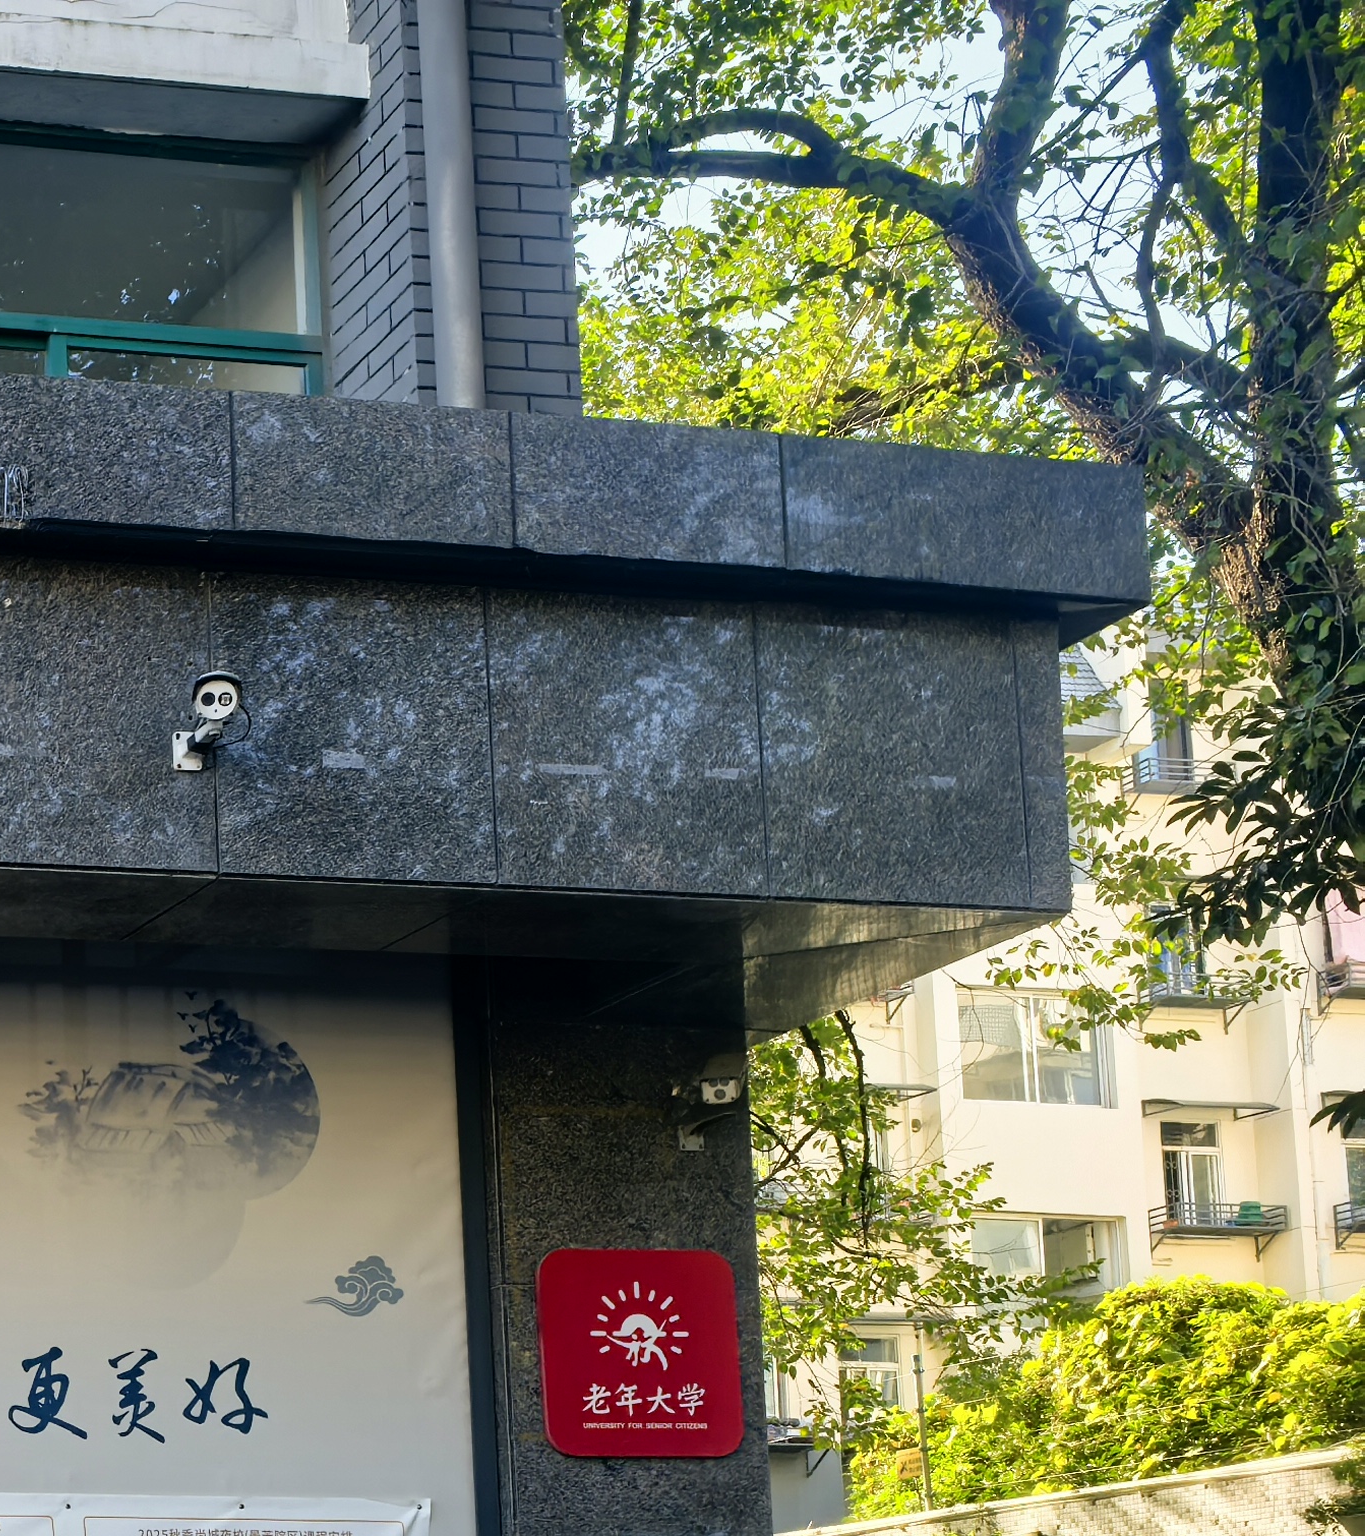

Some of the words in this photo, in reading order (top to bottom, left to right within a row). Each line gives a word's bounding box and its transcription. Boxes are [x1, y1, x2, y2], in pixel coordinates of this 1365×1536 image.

[582, 1383, 706, 1417] 老年大学
[583, 1422, 625, 1430] UNIVERSITY
[628, 1422, 643, 1430] FOR
[646, 1422, 673, 1430] SENIOR
[675, 1422, 708, 1430] CITIZENS
